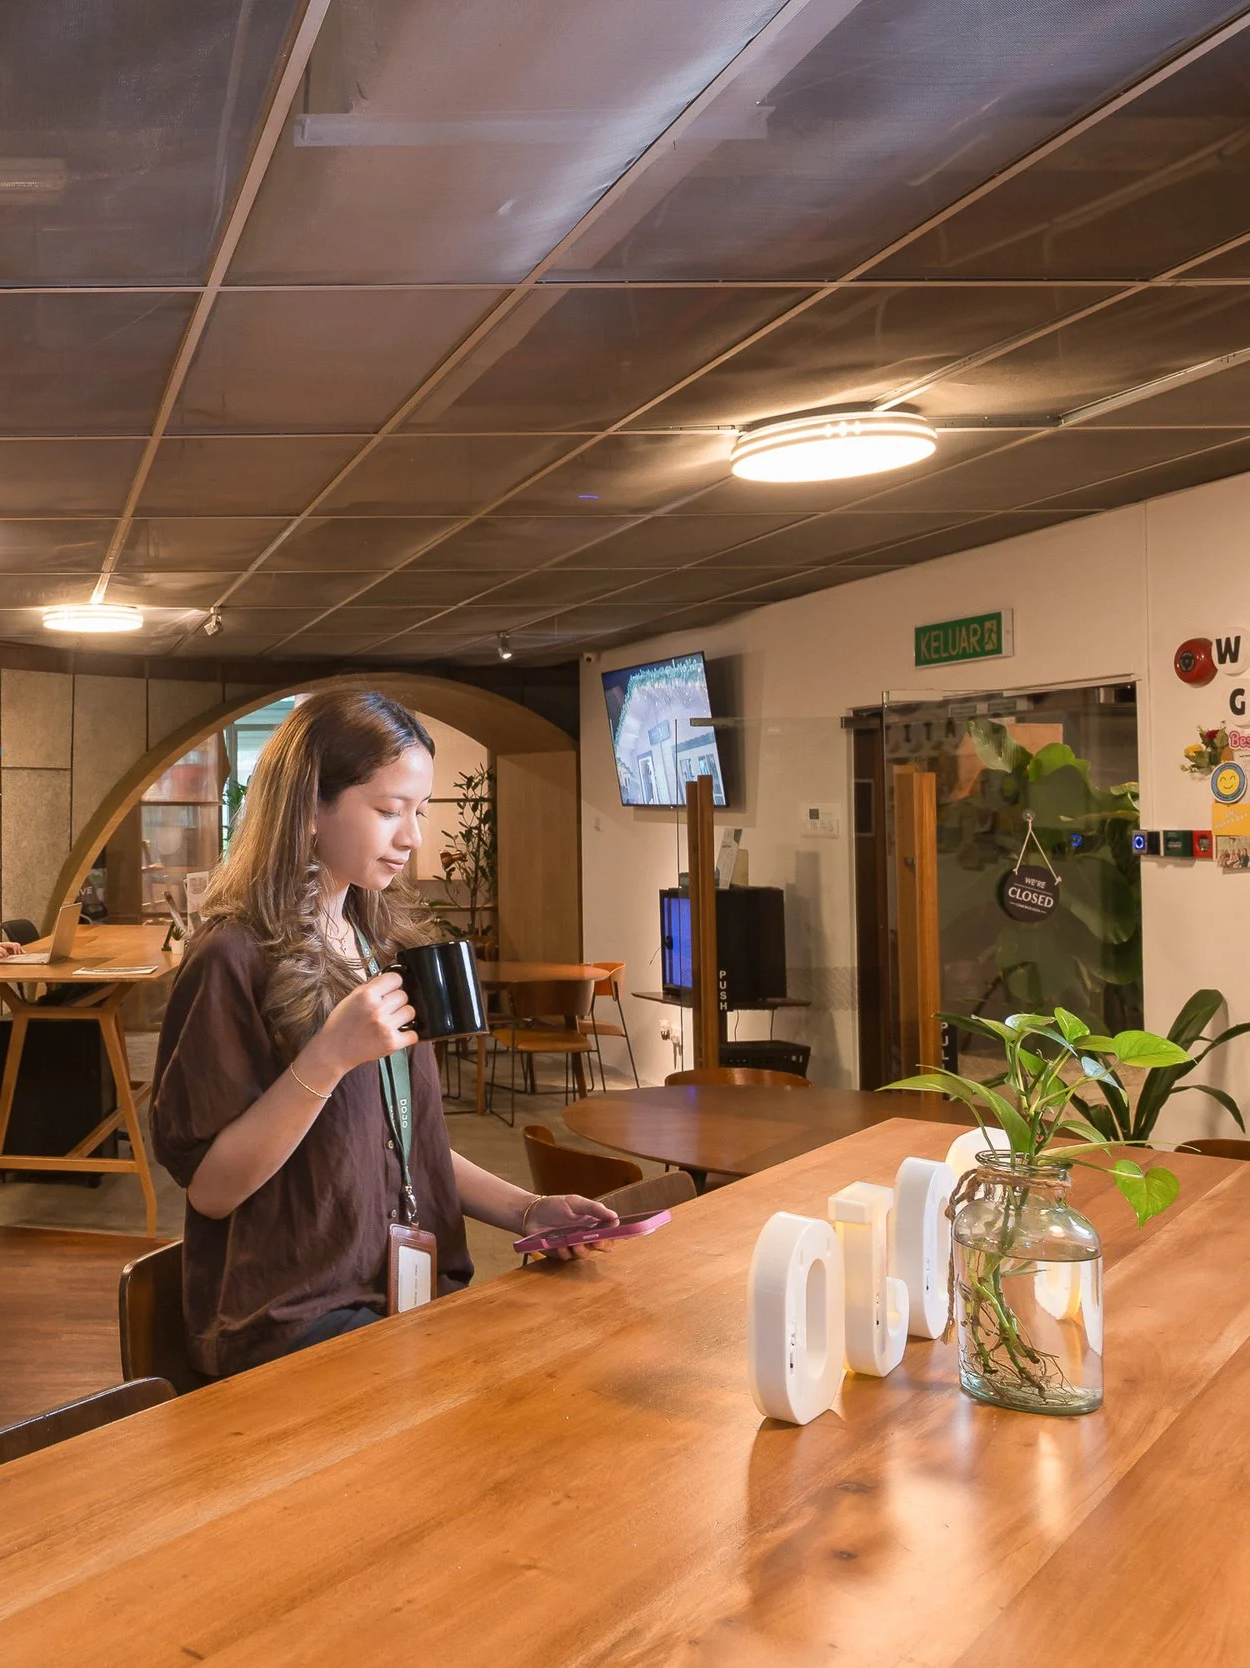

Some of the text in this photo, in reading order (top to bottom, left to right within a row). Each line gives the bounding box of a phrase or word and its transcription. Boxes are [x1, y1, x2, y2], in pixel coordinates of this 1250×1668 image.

[920, 623, 981, 660] KELUAR
[1215, 635, 1241, 665] W
[1229, 687, 1246, 717] G
[1008, 887, 1054, 909] CLOSED
[719, 970, 728, 1011] PUSH
